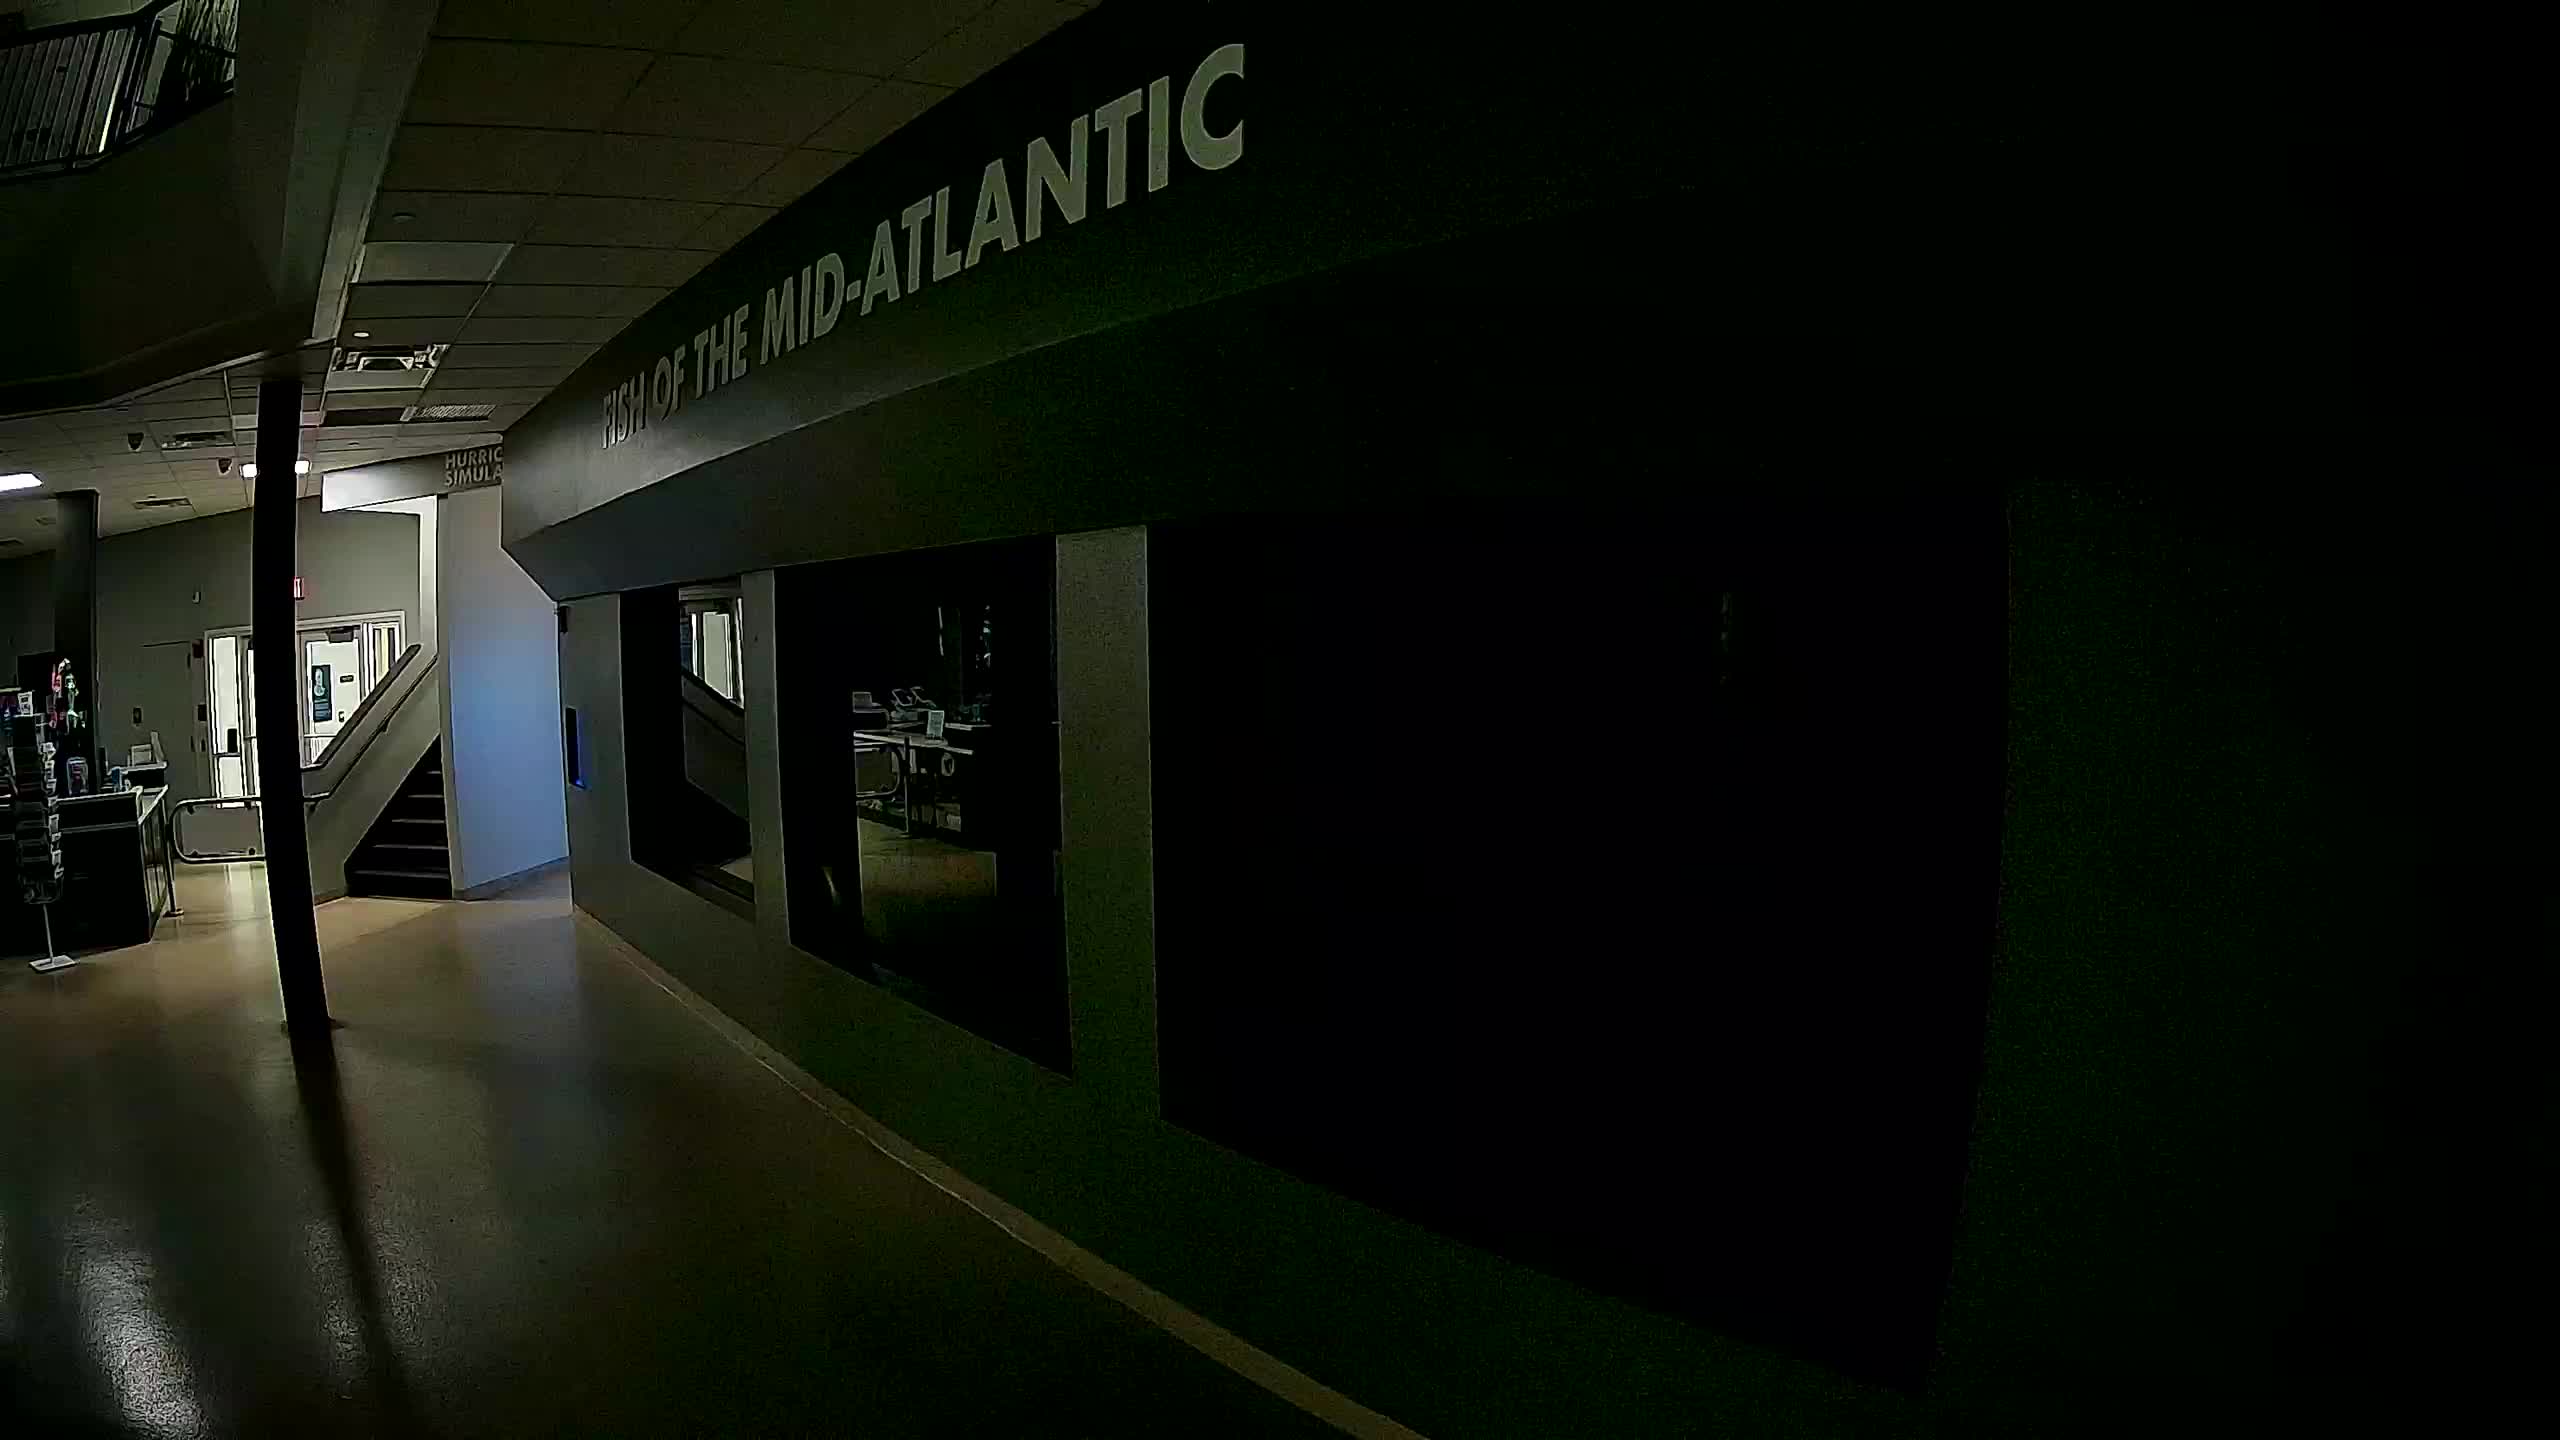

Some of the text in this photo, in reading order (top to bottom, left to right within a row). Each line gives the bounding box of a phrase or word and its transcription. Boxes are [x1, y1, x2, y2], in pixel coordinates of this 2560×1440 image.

[602, 43, 1245, 449] FISH OF THE MID-ATLANTIC
[445, 446, 504, 469] HURRIC
